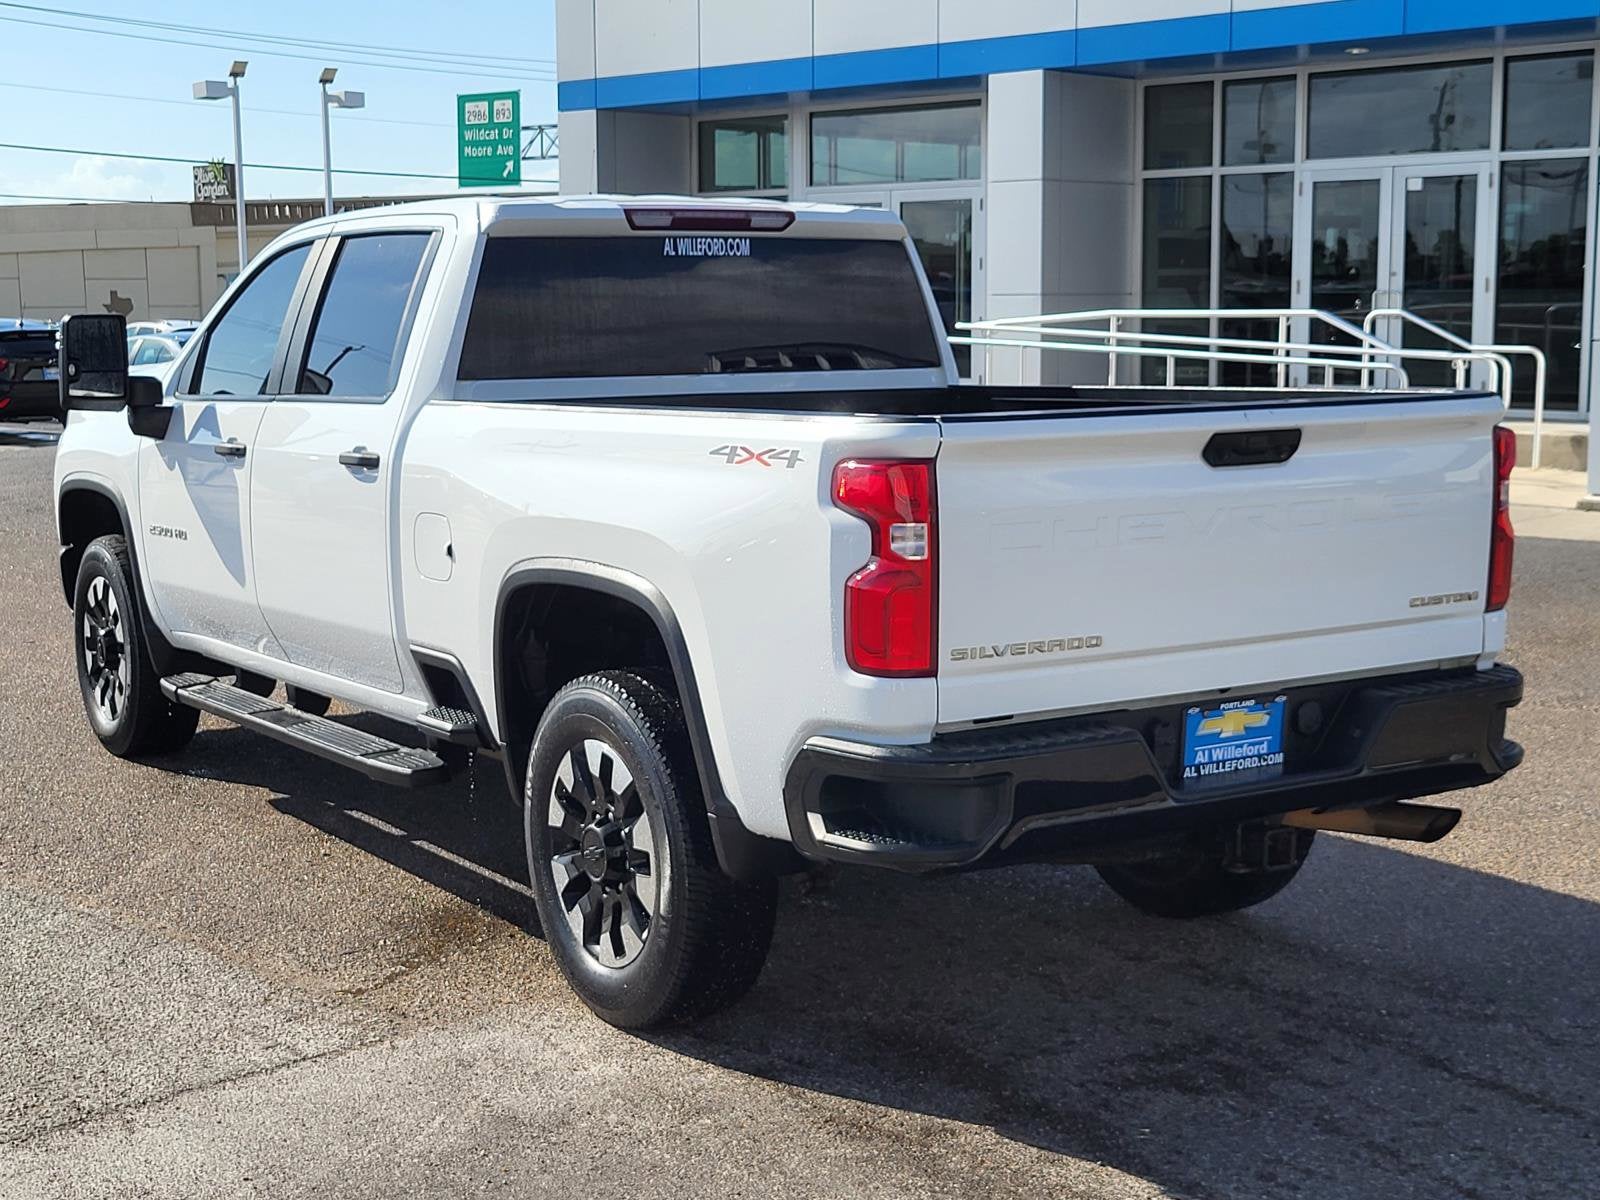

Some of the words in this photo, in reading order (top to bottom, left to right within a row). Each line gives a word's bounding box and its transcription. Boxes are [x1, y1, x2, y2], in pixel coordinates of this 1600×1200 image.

[467, 109, 488, 122] 2986
[495, 107, 511, 121] 893
[464, 129, 499, 141] Wildcat
[502, 128, 513, 139] Dr
[464, 146, 493, 157] Moore
[497, 144, 514, 156] Ave
[663, 237, 676, 256] AL
[676, 237, 750, 256] WILLEFORD.COM
[1409, 591, 1479, 608] CUSTOM
[950, 635, 1103, 662] SILVERADO
[1220, 700, 1255, 710] PORTLAND
[1195, 747, 1210, 764] Al
[1211, 740, 1268, 762] Willeford
[1183, 766, 1198, 778] AL
[1200, 752, 1284, 776] WILLEFORD.COM
